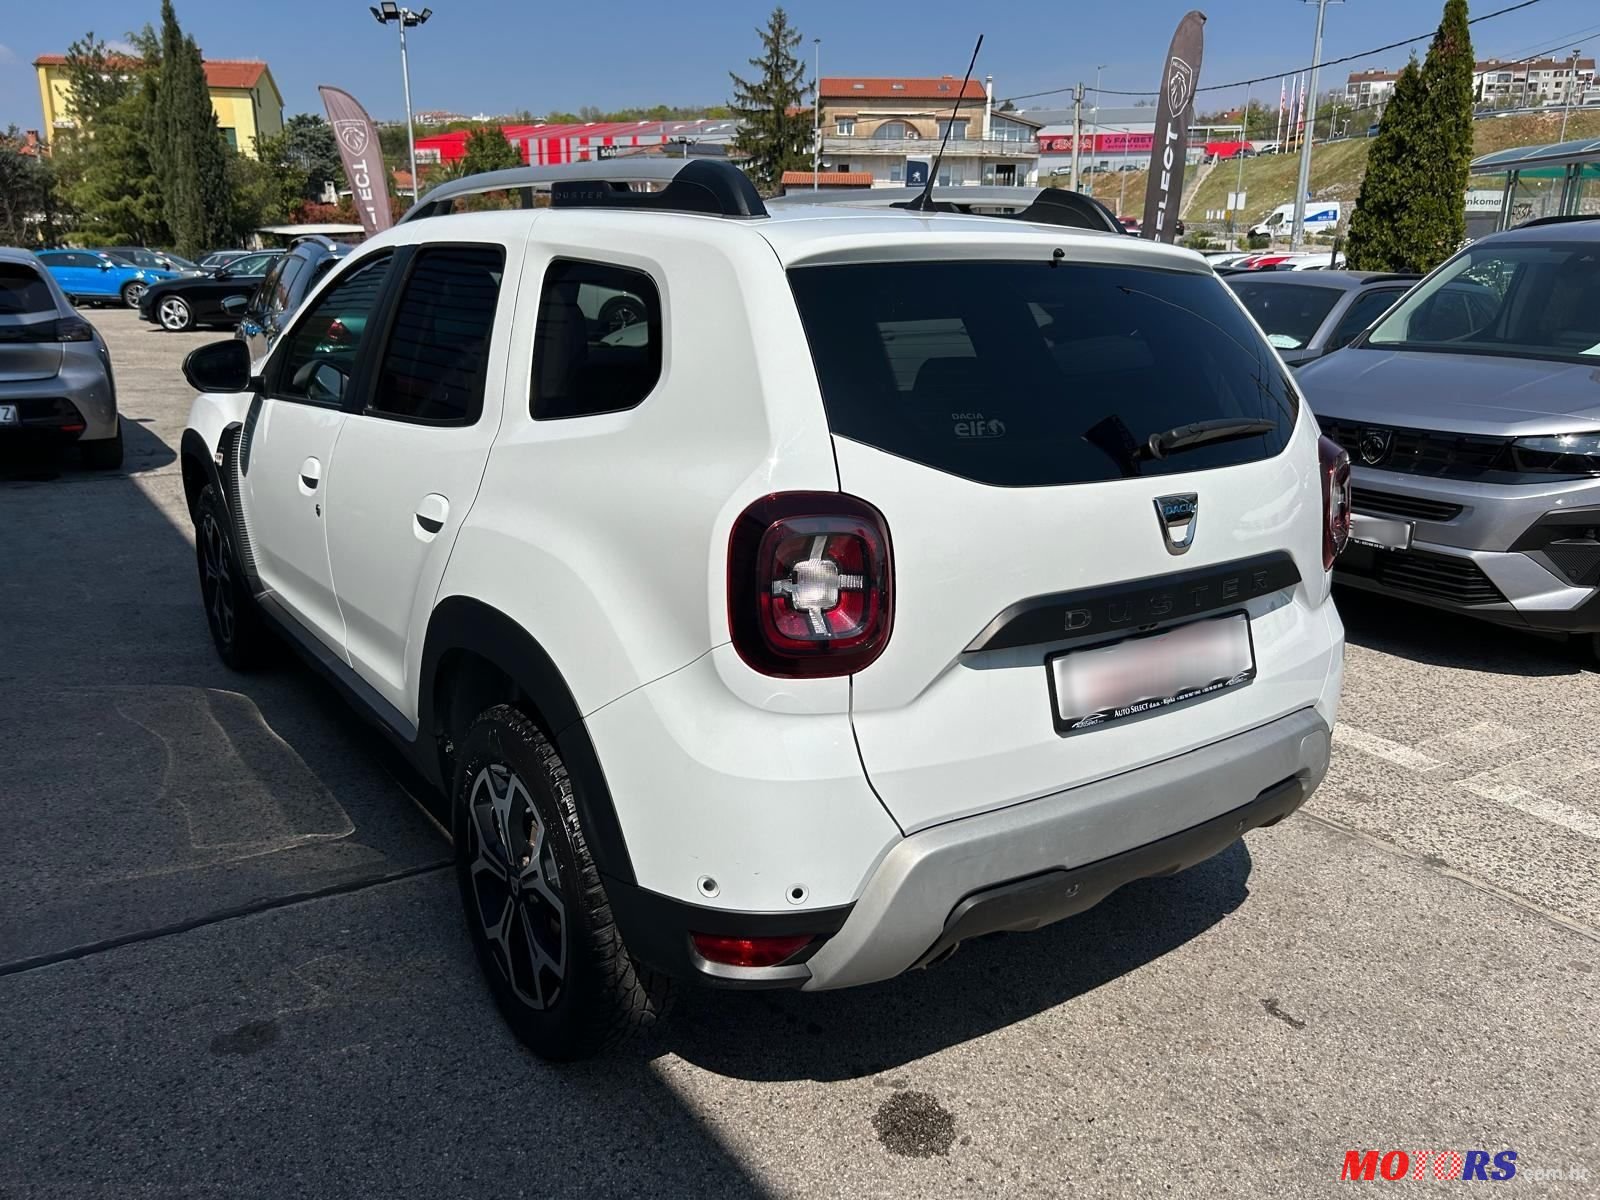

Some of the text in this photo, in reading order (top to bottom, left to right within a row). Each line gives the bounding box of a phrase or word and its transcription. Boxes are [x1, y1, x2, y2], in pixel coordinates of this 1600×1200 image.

[555, 191, 604, 200] DUSTER
[952, 412, 984, 420] DACIA
[954, 421, 986, 436] elf
[1165, 503, 1195, 515] DACIA
[1064, 570, 1268, 631] DUSTER
[1114, 705, 1131, 718] AUTO
[1130, 702, 1149, 714] SELECT
